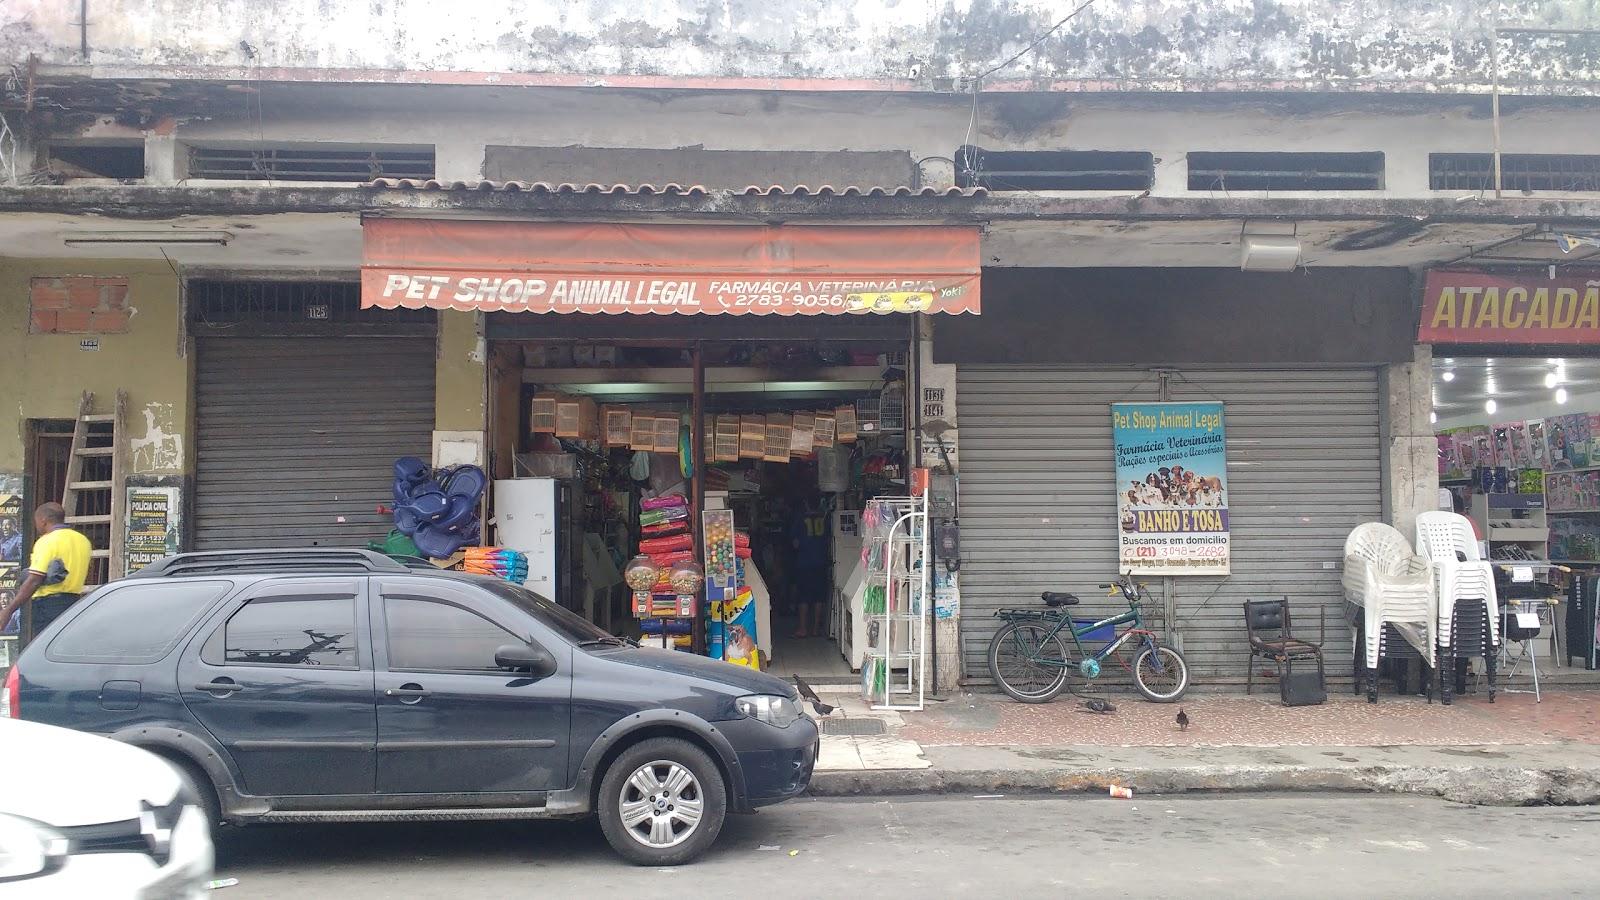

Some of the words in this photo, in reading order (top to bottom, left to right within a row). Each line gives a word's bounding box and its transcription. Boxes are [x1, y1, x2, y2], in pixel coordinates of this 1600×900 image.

[382, 274, 450, 299] PET
[453, 277, 547, 303] SHOP
[550, 280, 631, 305] ANIMAL
[633, 281, 700, 305] LEGAL
[708, 280, 802, 294] FARMÁCIA
[1430, 279, 1600, 329] ATACADÃ
[1114, 411, 1130, 428] Pet
[1132, 411, 1157, 432] Shop
[1159, 410, 1192, 429] Animal
[1195, 411, 1222, 431] Legal
[1116, 441, 1164, 457] Farmácia
[1167, 433, 1222, 448] Veterinária
[1118, 454, 1147, 468] Rações
[1148, 450, 1183, 466] especiais
[131, 500, 153, 511] POLÍCIA
[153, 501, 168, 511] CIVIL
[1138, 511, 1180, 532] BANHO
[1183, 511, 1191, 531] E
[1193, 511, 1223, 531] TOSA
[1122, 536, 1167, 545] Buscamos
[1170, 537, 1184, 545] em
[129, 552, 151, 563] POLÍCIA
[1136, 546, 1157, 557] (21)
